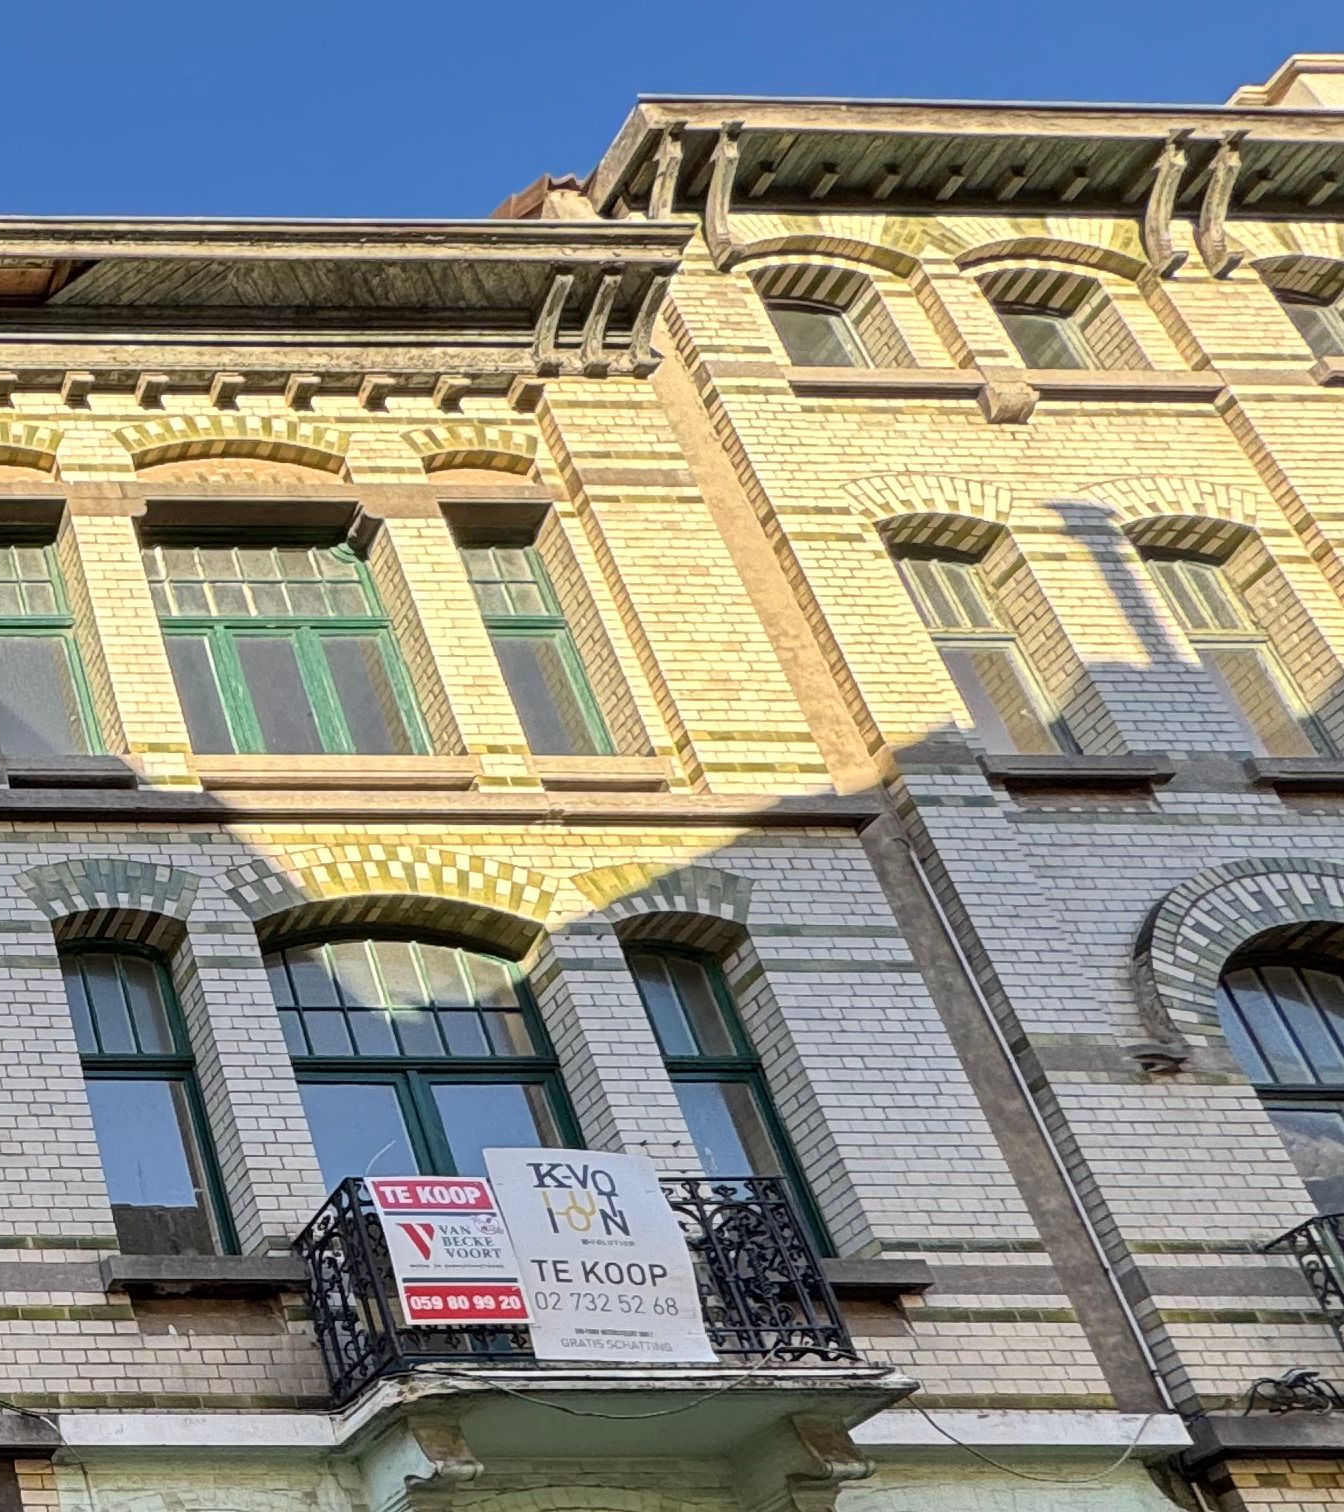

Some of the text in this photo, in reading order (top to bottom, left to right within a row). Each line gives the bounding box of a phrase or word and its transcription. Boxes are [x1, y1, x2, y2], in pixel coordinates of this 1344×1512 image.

[378, 1185, 481, 1205] TE KOOP
[437, 1224, 471, 1235] VAN
[441, 1236, 495, 1247] BECKE
[444, 1248, 502, 1259] VOORT
[530, 1259, 668, 1287] TE KOOP
[410, 1295, 522, 1310] 059 80 99 20
[534, 1291, 679, 1316] 02 732 52 68
[561, 1338, 673, 1352] GRATIS SCHATTING
